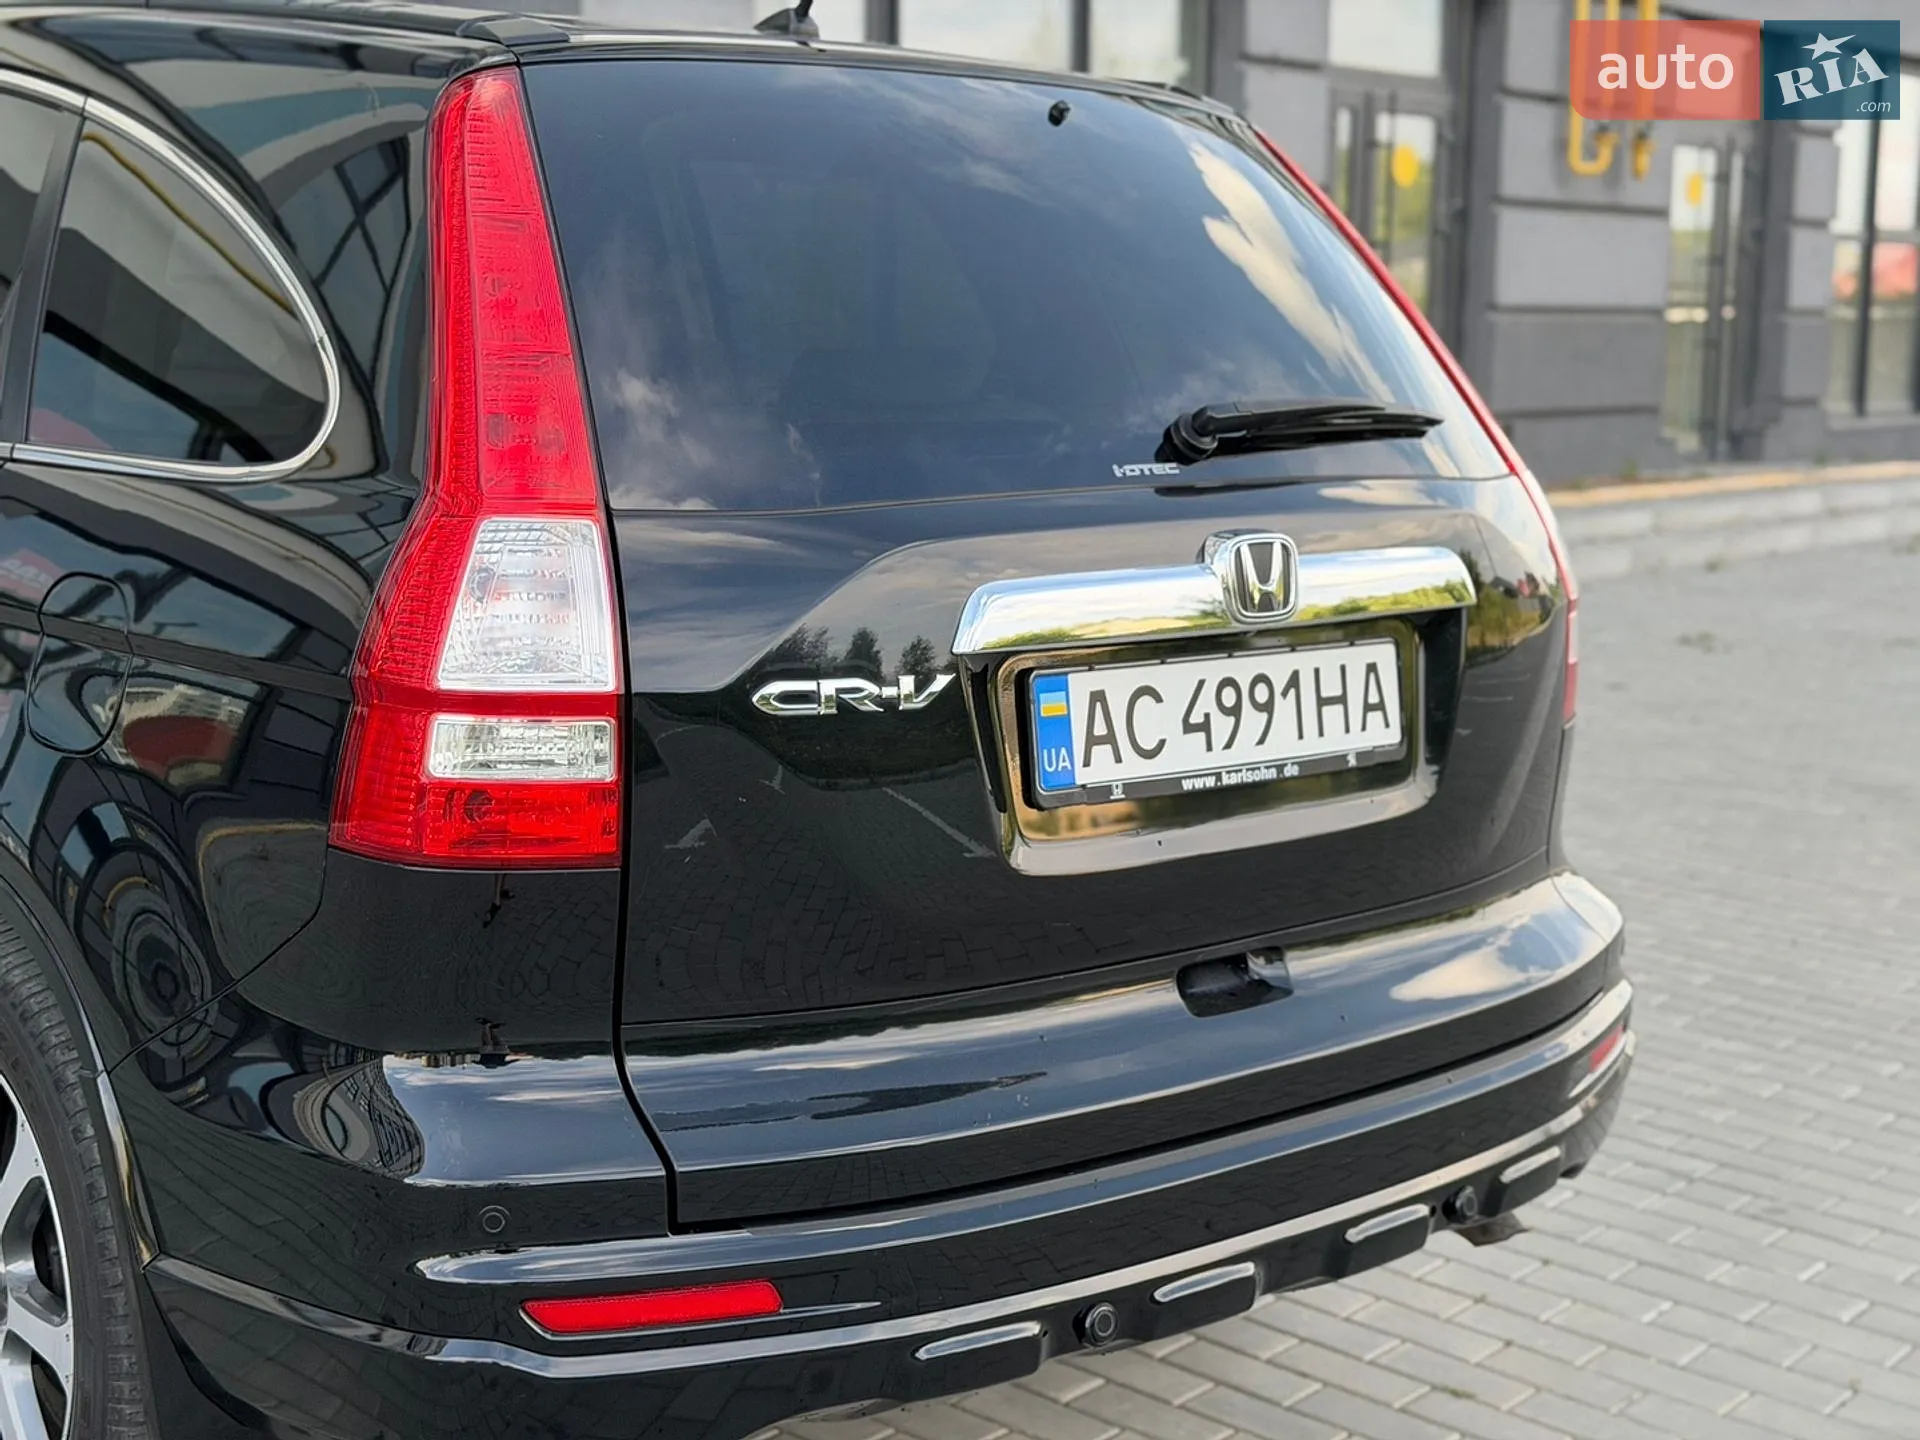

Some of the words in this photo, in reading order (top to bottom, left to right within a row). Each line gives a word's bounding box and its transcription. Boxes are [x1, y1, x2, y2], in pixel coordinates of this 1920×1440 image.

[752, 672, 957, 716] CR-V
[1081, 683, 1168, 769] AC
[1042, 746, 1072, 773] UA
